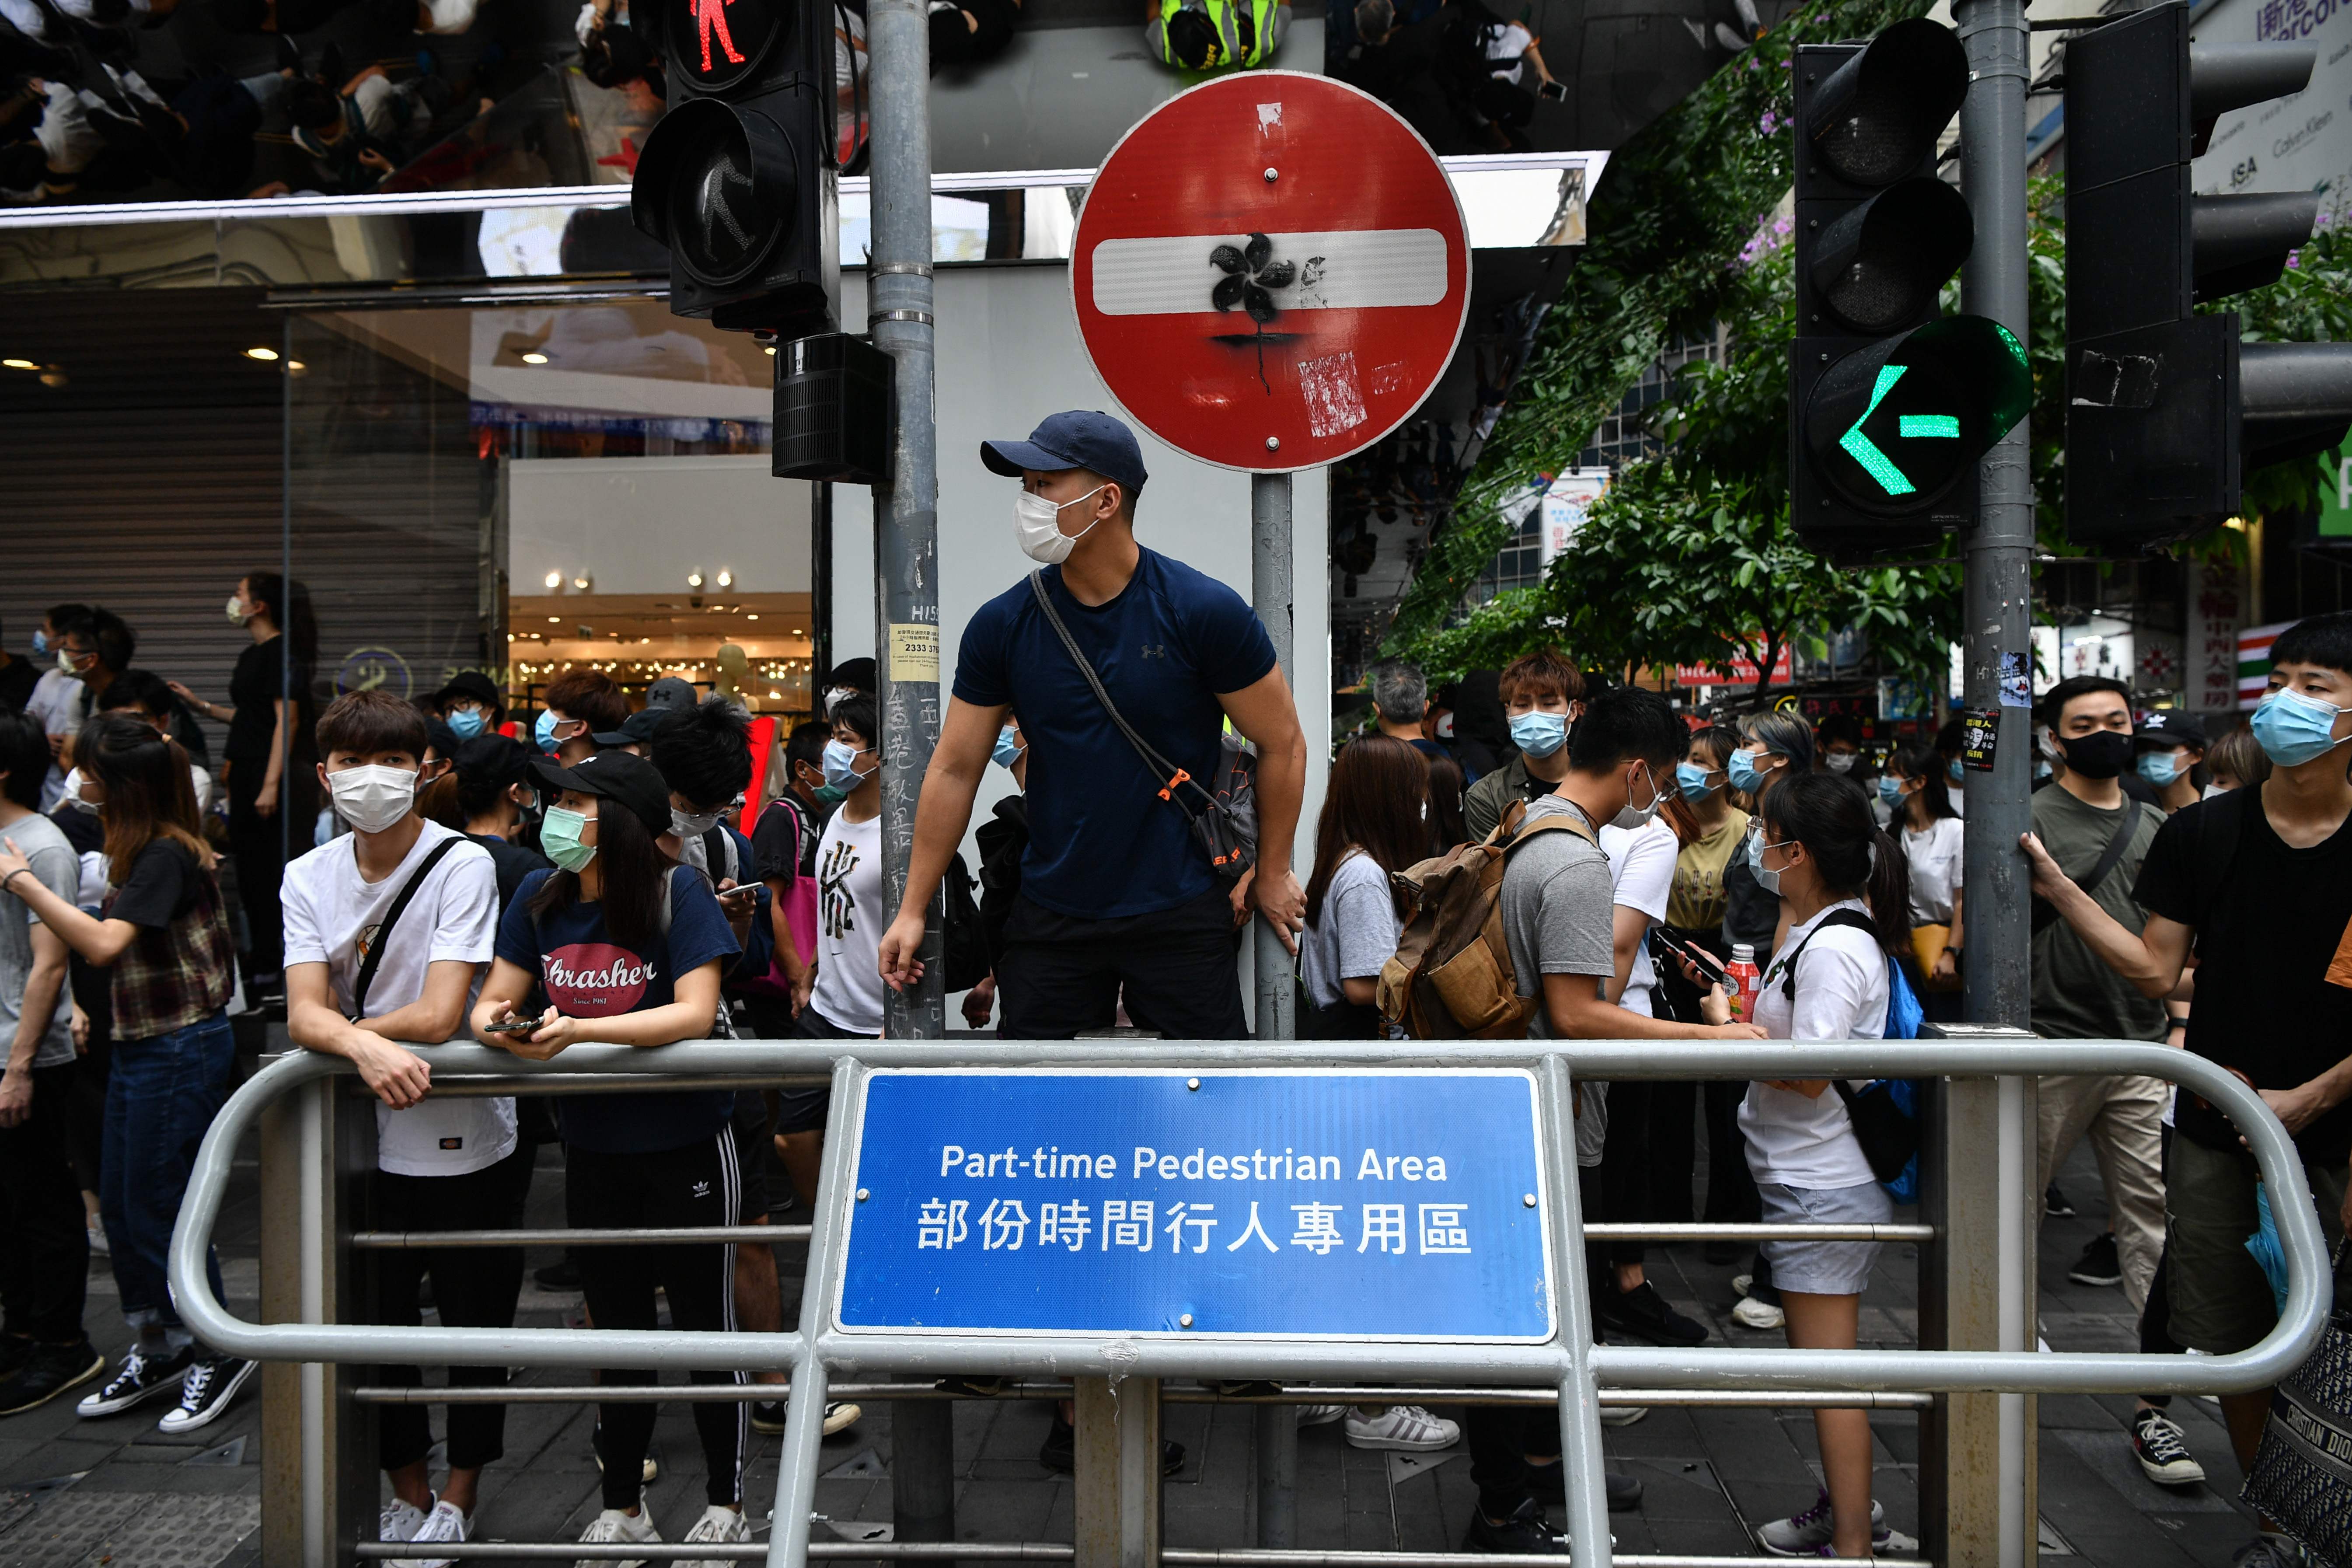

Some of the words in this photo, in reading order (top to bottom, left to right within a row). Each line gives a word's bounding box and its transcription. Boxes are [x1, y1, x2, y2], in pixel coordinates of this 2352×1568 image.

[905, 643, 927, 652] 2333
[1966, 719, 1992, 728] 香港人
[1967, 750, 1983, 759] 反抗
[541, 954, 656, 988] Thrasher
[940, 1145, 1117, 1179] Part-time
[1134, 1147, 1341, 1181] Pedestrian
[1357, 1148, 1448, 1181] Area
[917, 1197, 1472, 1256] 部份時間行人專用區
